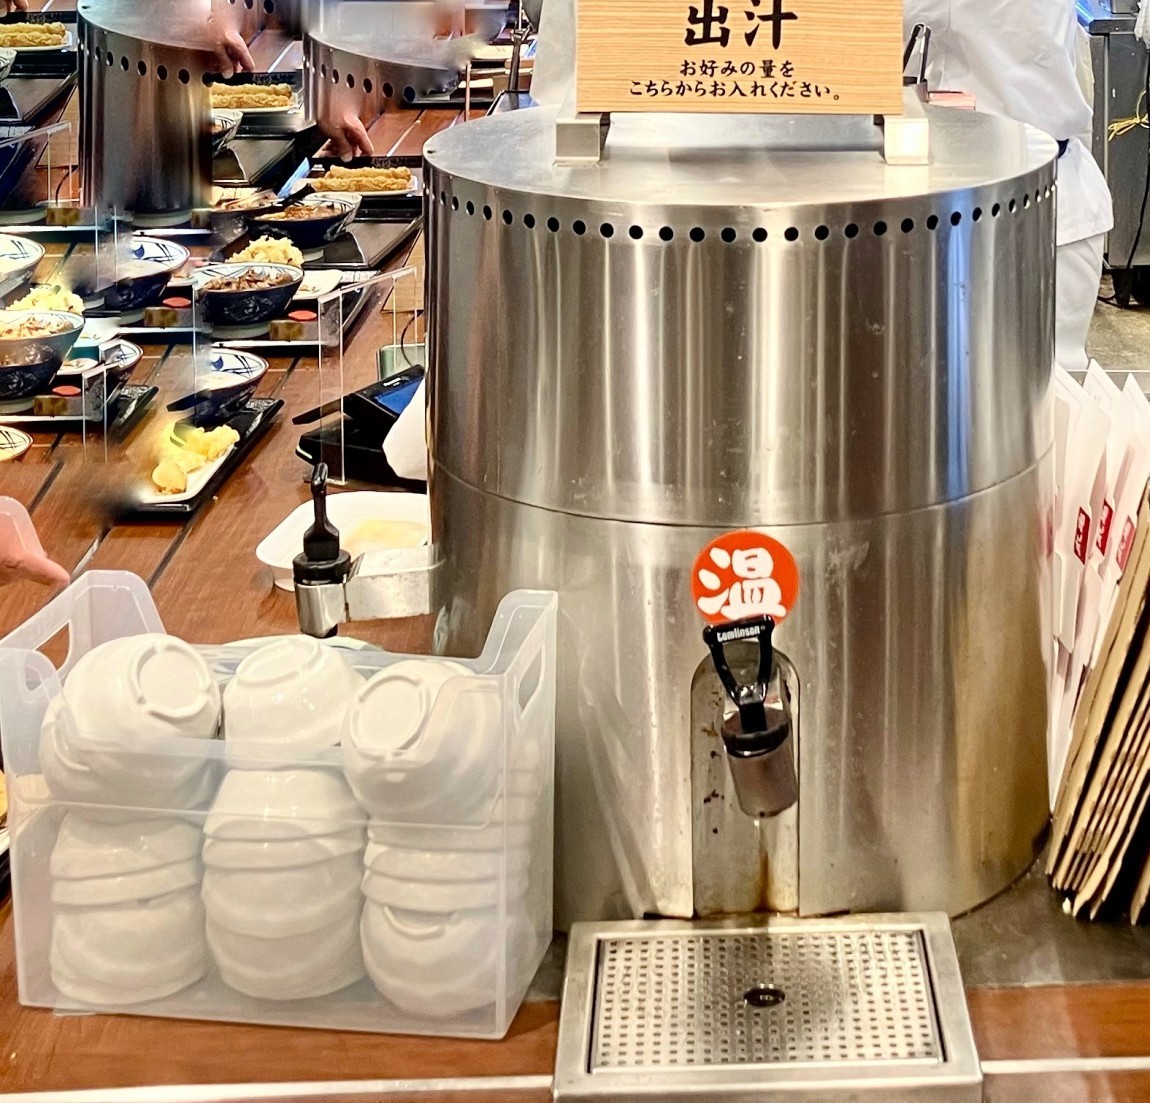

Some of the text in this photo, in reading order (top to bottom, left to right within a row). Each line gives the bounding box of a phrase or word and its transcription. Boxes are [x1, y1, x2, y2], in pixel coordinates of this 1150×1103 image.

[680, 59, 794, 77] お好みの量を
[629, 80, 840, 100] こちらからお入れください。
[697, 547, 786, 621] 温
